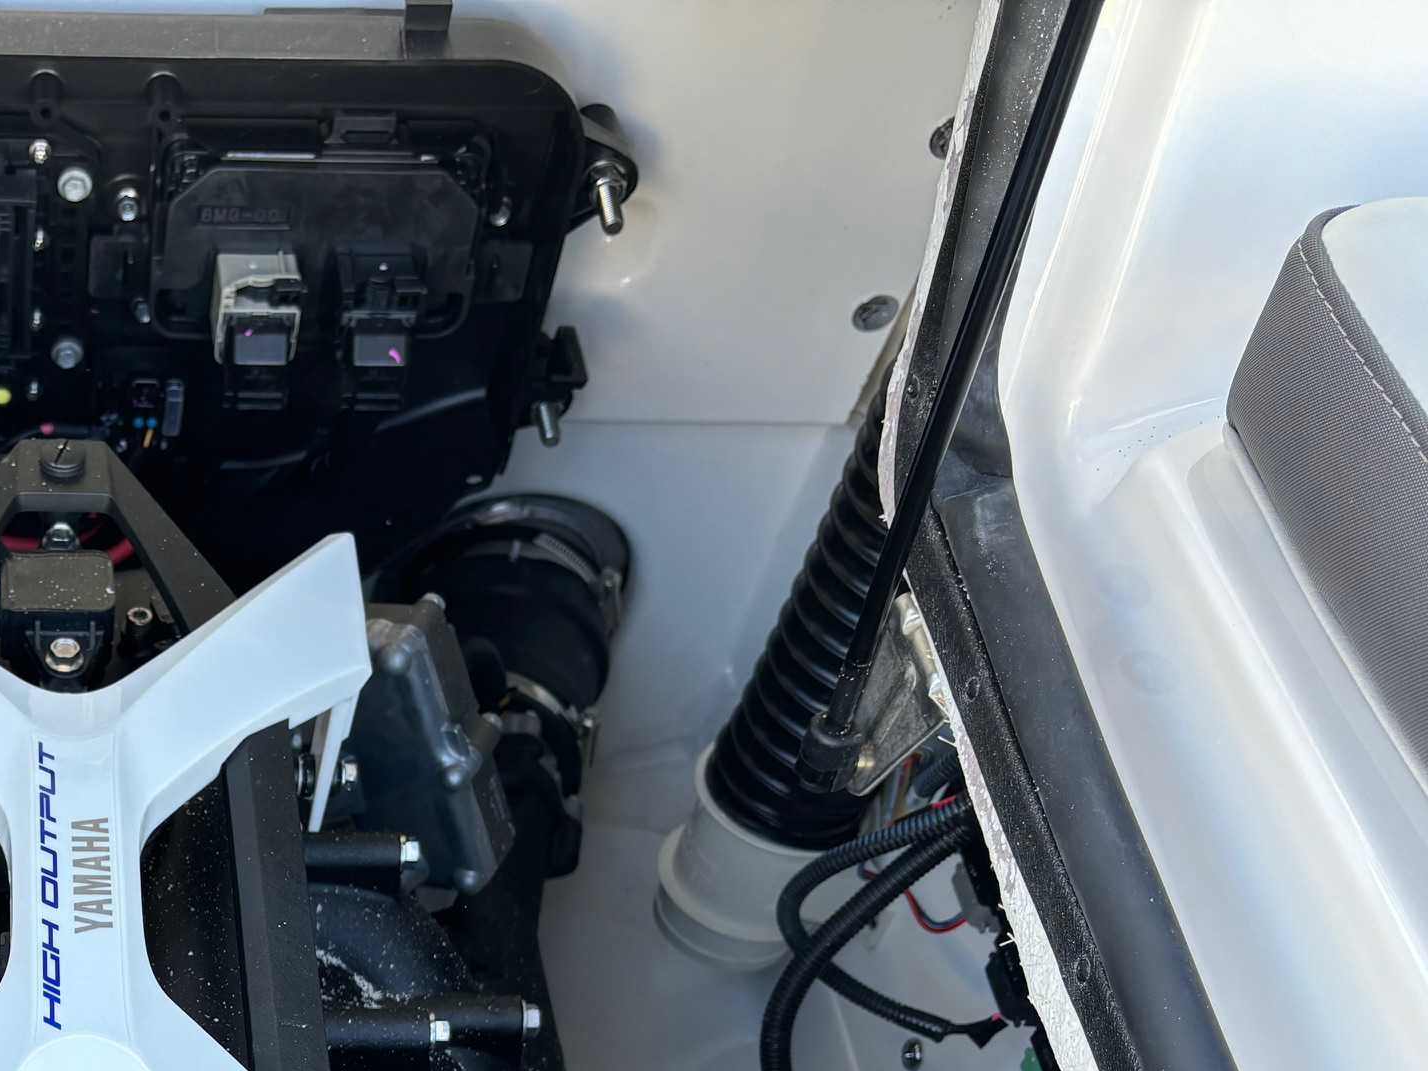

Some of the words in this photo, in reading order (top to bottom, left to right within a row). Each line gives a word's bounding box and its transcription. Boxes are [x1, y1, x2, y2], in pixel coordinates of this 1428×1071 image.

[38, 741, 59, 909] OUTPUT
[71, 817, 114, 934] YAMAHA
[42, 919, 62, 1030] HIGH
